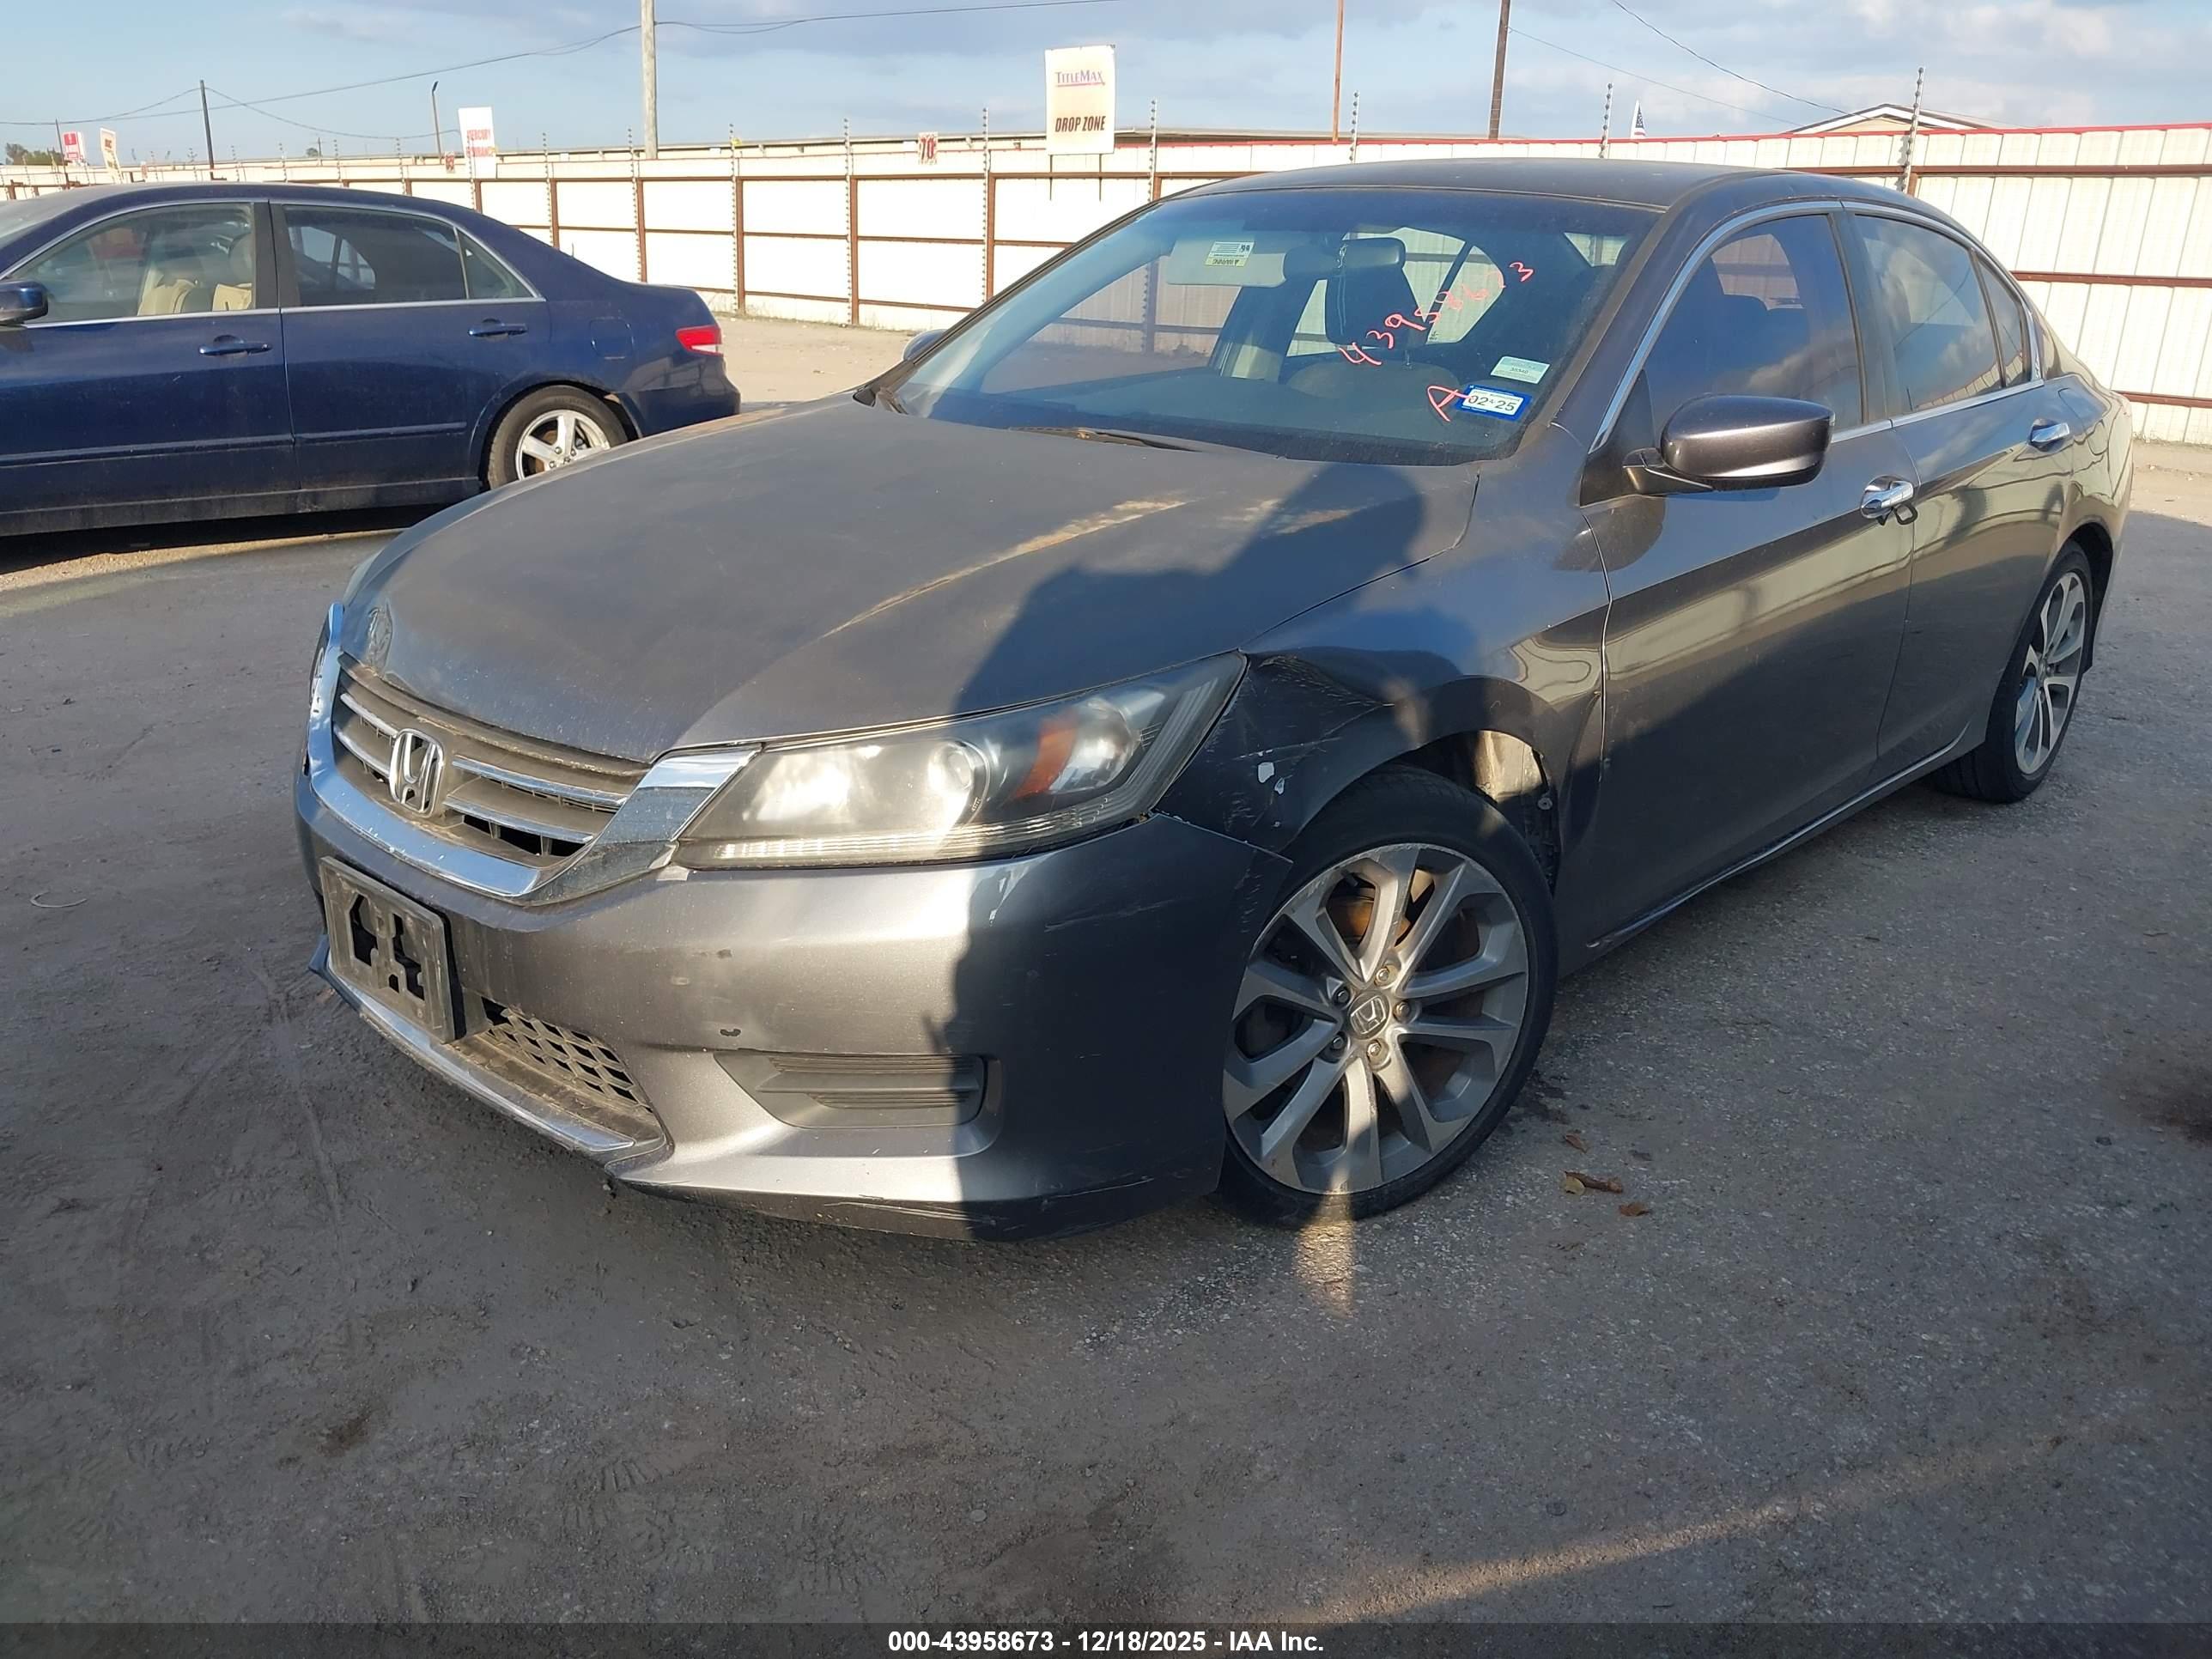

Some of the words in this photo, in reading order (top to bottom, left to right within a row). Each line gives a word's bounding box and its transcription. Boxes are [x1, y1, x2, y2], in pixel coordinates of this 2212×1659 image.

[1055, 117, 1081, 131] DROP
[1083, 116, 1106, 131] ZONE
[1468, 395, 1489, 406] 02
[1495, 400, 1516, 411] 25
